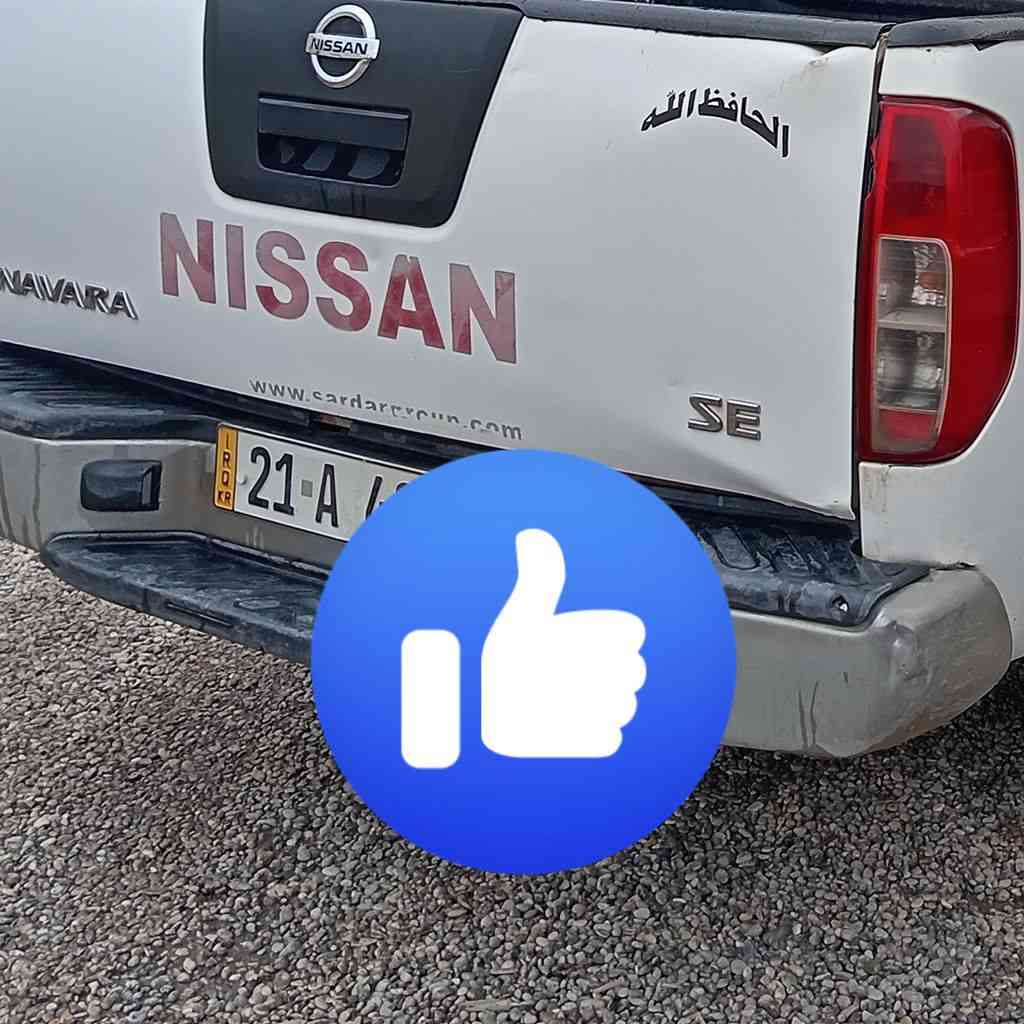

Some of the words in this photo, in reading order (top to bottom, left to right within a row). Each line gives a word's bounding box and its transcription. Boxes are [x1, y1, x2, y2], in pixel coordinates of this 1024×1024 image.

[311, 37, 369, 55] NISSAN
[640, 87, 698, 132] الله
[698, 87, 790, 158] الحافظ
[0, 266, 140, 320] NAVARA
[159, 211, 517, 364] NISSAN
[687, 392, 762, 441] SE
[248, 446, 294, 515] 21
[315, 463, 339, 527] A
